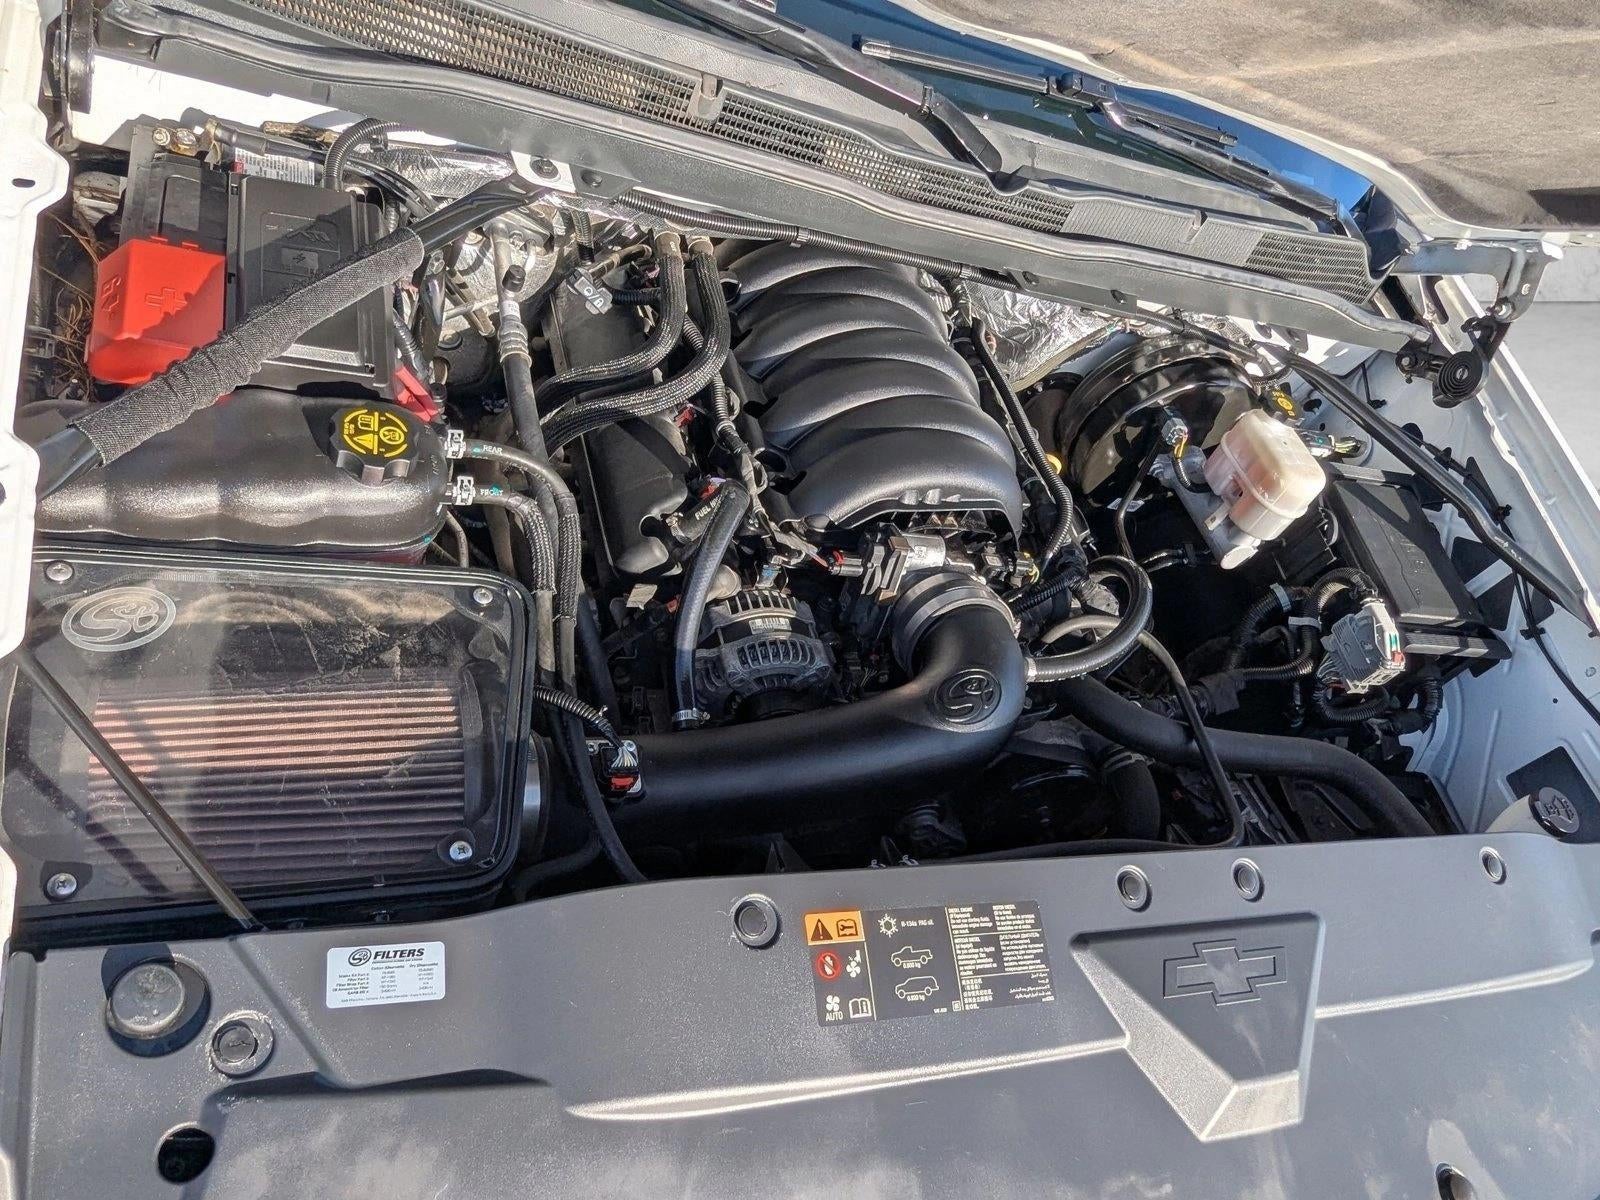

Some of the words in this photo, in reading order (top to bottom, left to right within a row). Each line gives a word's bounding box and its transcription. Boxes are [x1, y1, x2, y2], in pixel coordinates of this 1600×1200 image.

[483, 444, 503, 456] REAR
[695, 505, 711, 520] FUEL
[374, 948, 425, 960] FILTERS
[825, 1010, 844, 1022] AUTO
